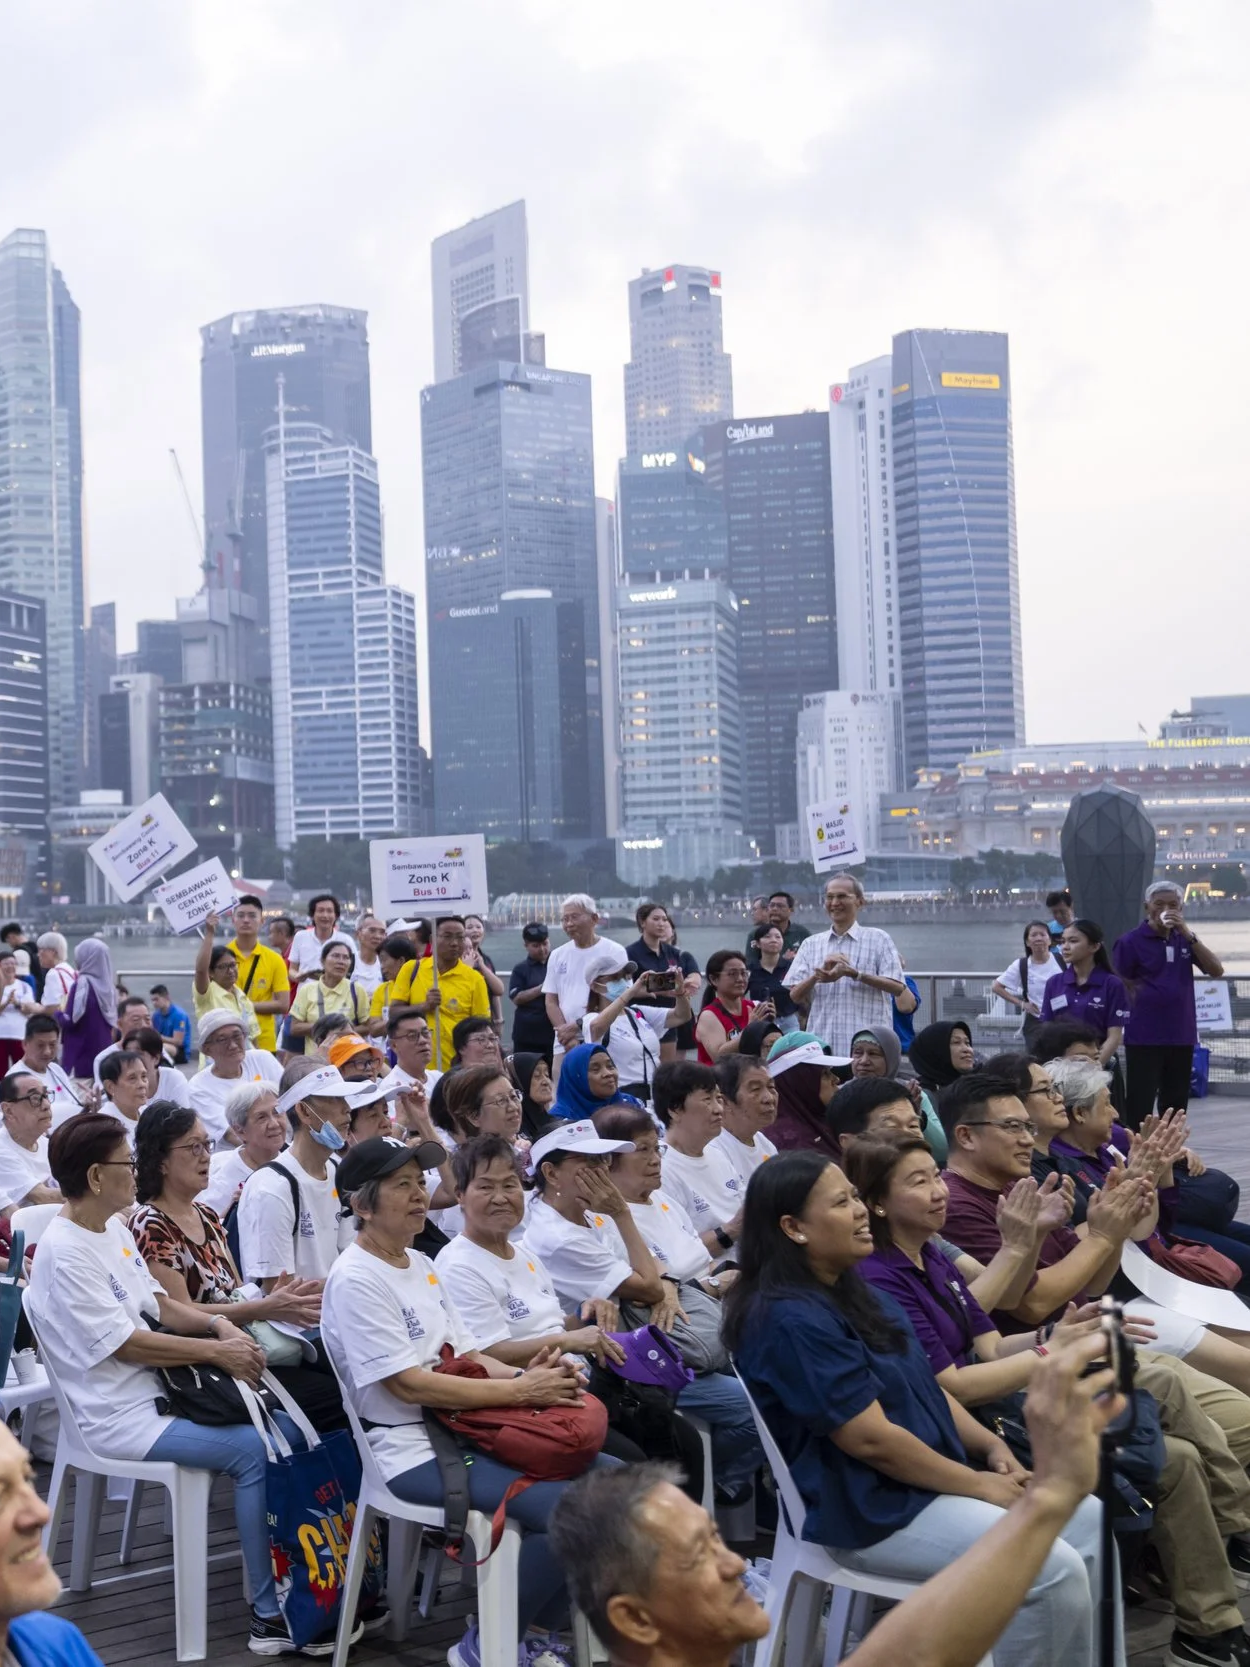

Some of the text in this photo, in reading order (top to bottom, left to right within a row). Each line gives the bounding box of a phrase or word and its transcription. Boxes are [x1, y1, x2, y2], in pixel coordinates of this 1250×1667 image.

[642, 452, 678, 468] MYP
[630, 586, 677, 603] wework
[1148, 739, 1165, 749] THE
[826, 818, 844, 829] MASJID
[126, 837, 157, 864] Zone K
[136, 858, 151, 870] Bus
[391, 860, 465, 871] Sembawang Central
[408, 872, 450, 884] Zone K
[165, 873, 218, 905] SEMBAWANG
[413, 887, 447, 896] Bus 10
[177, 888, 216, 910] CENTRAL
[186, 897, 220, 919] ZONE K
[314, 1481, 336, 1505] GET
